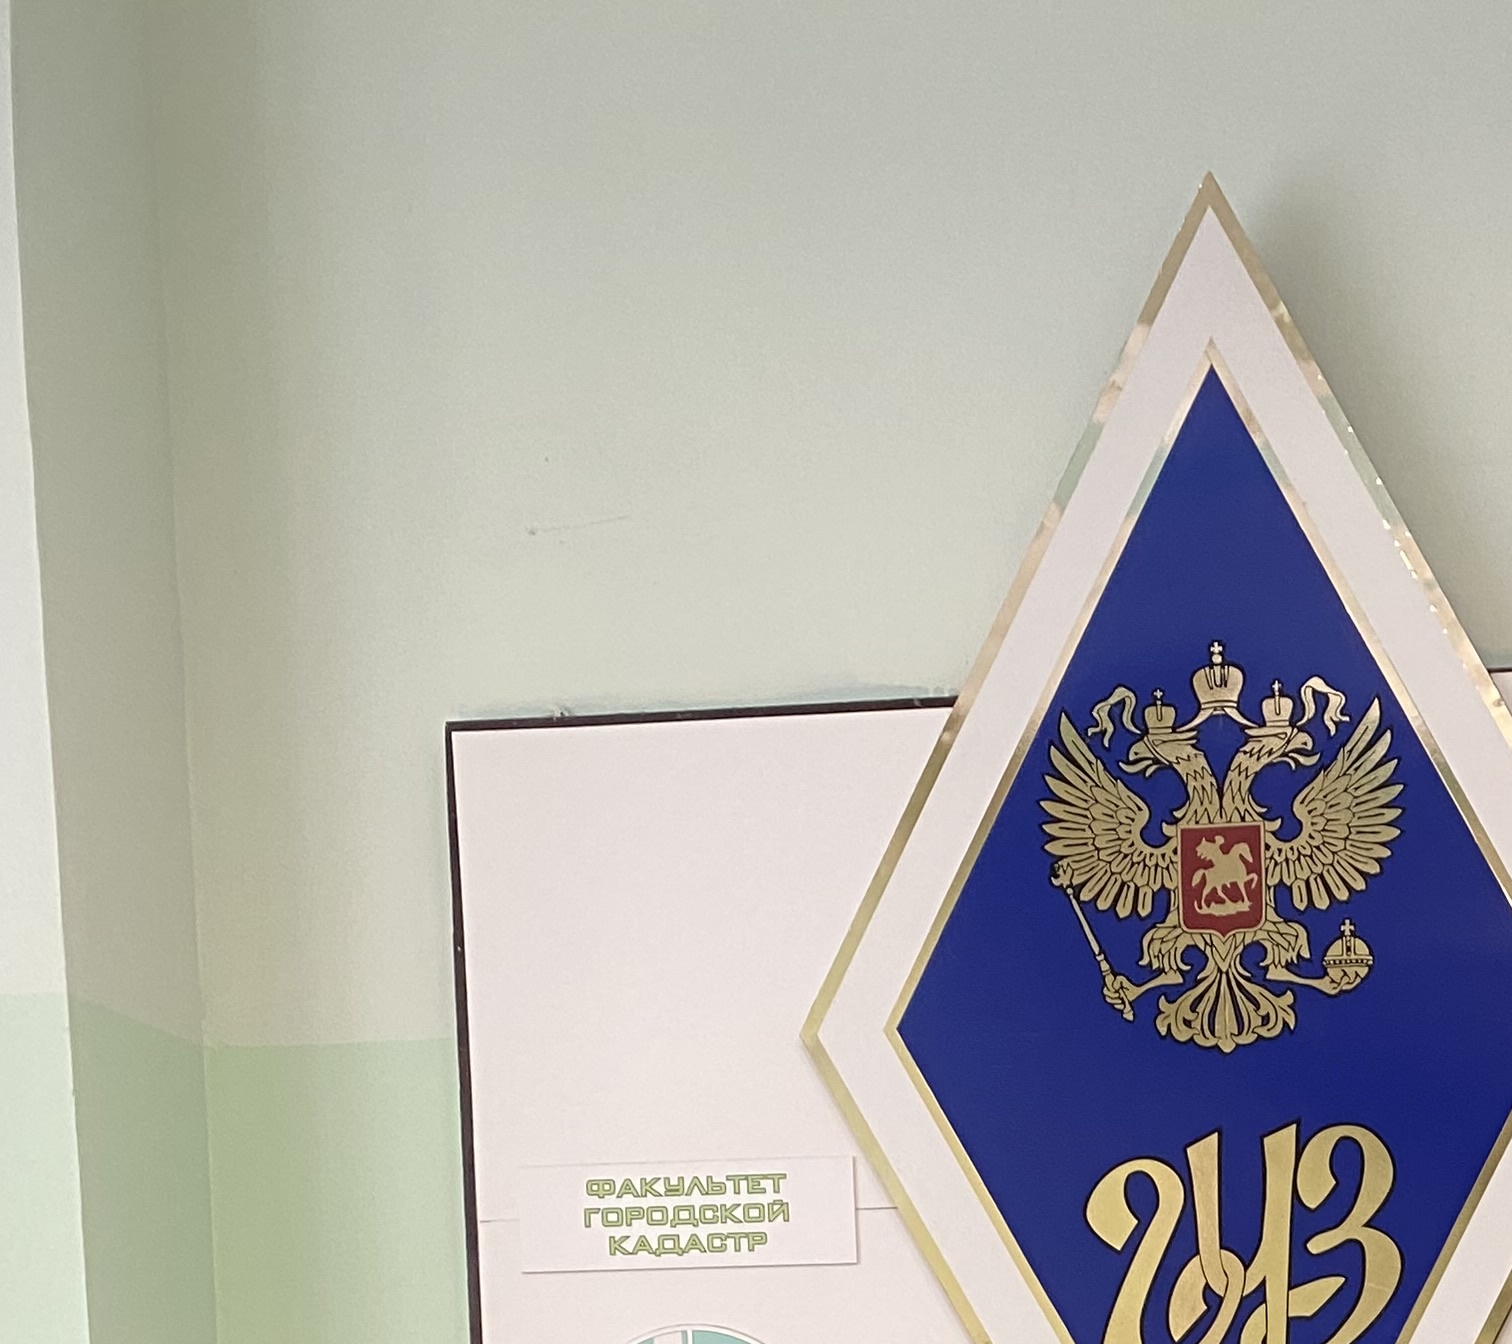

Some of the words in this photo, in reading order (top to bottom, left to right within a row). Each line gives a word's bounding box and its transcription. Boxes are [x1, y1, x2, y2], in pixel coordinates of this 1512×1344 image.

[585, 1173, 787, 1198] ФАКУЛЬТЕТ
[583, 1199, 790, 1228] ГОРОДСКОЙ
[608, 1231, 768, 1257] КАДАСТР
